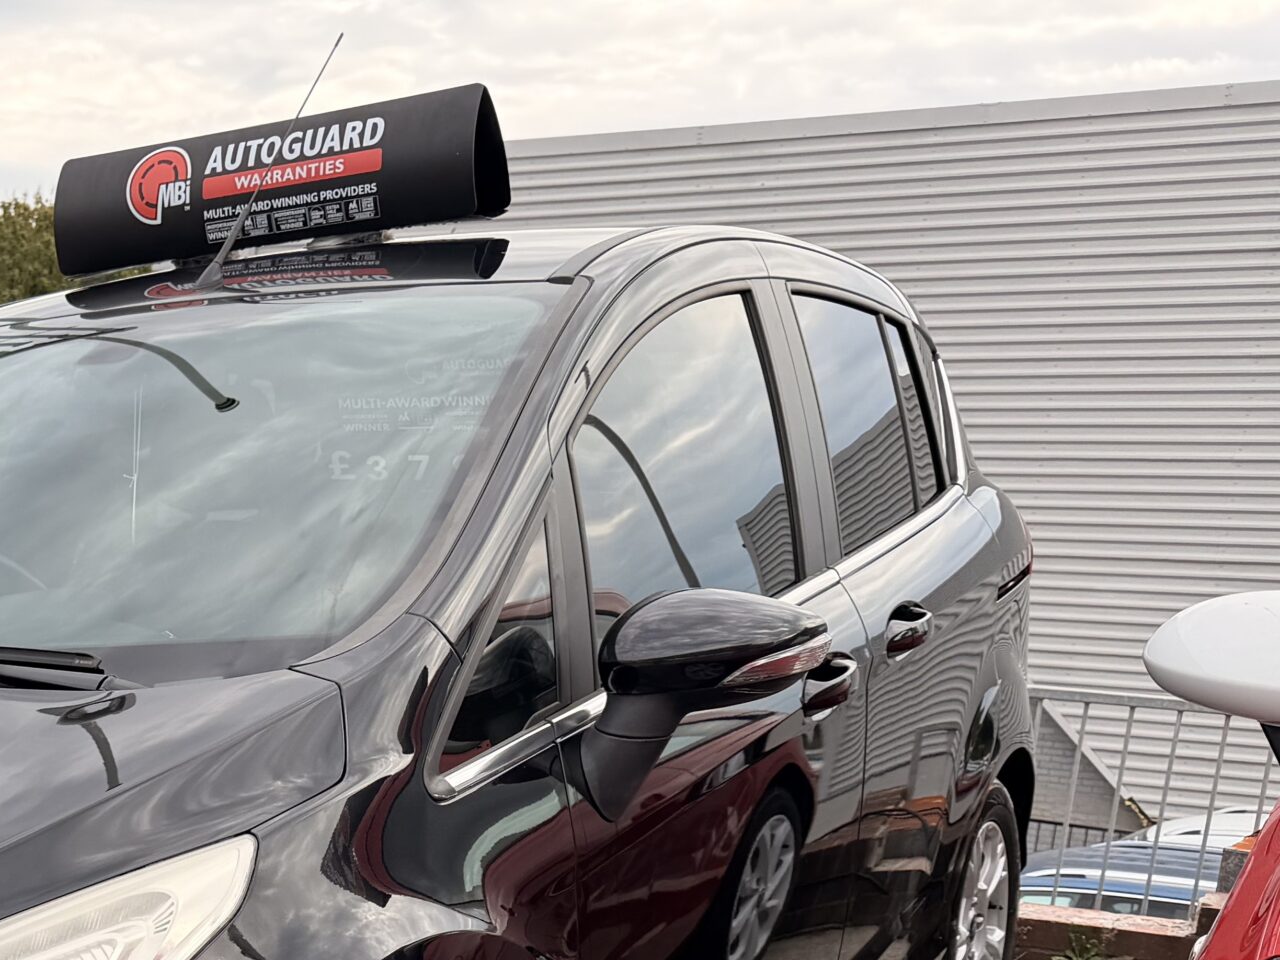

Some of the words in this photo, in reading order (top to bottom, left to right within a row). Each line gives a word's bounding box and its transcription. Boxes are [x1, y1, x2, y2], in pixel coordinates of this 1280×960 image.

[204, 116, 385, 175] AUTOGUARD
[234, 158, 345, 190] WARRANTIES
[320, 183, 377, 205] PROVIDERS
